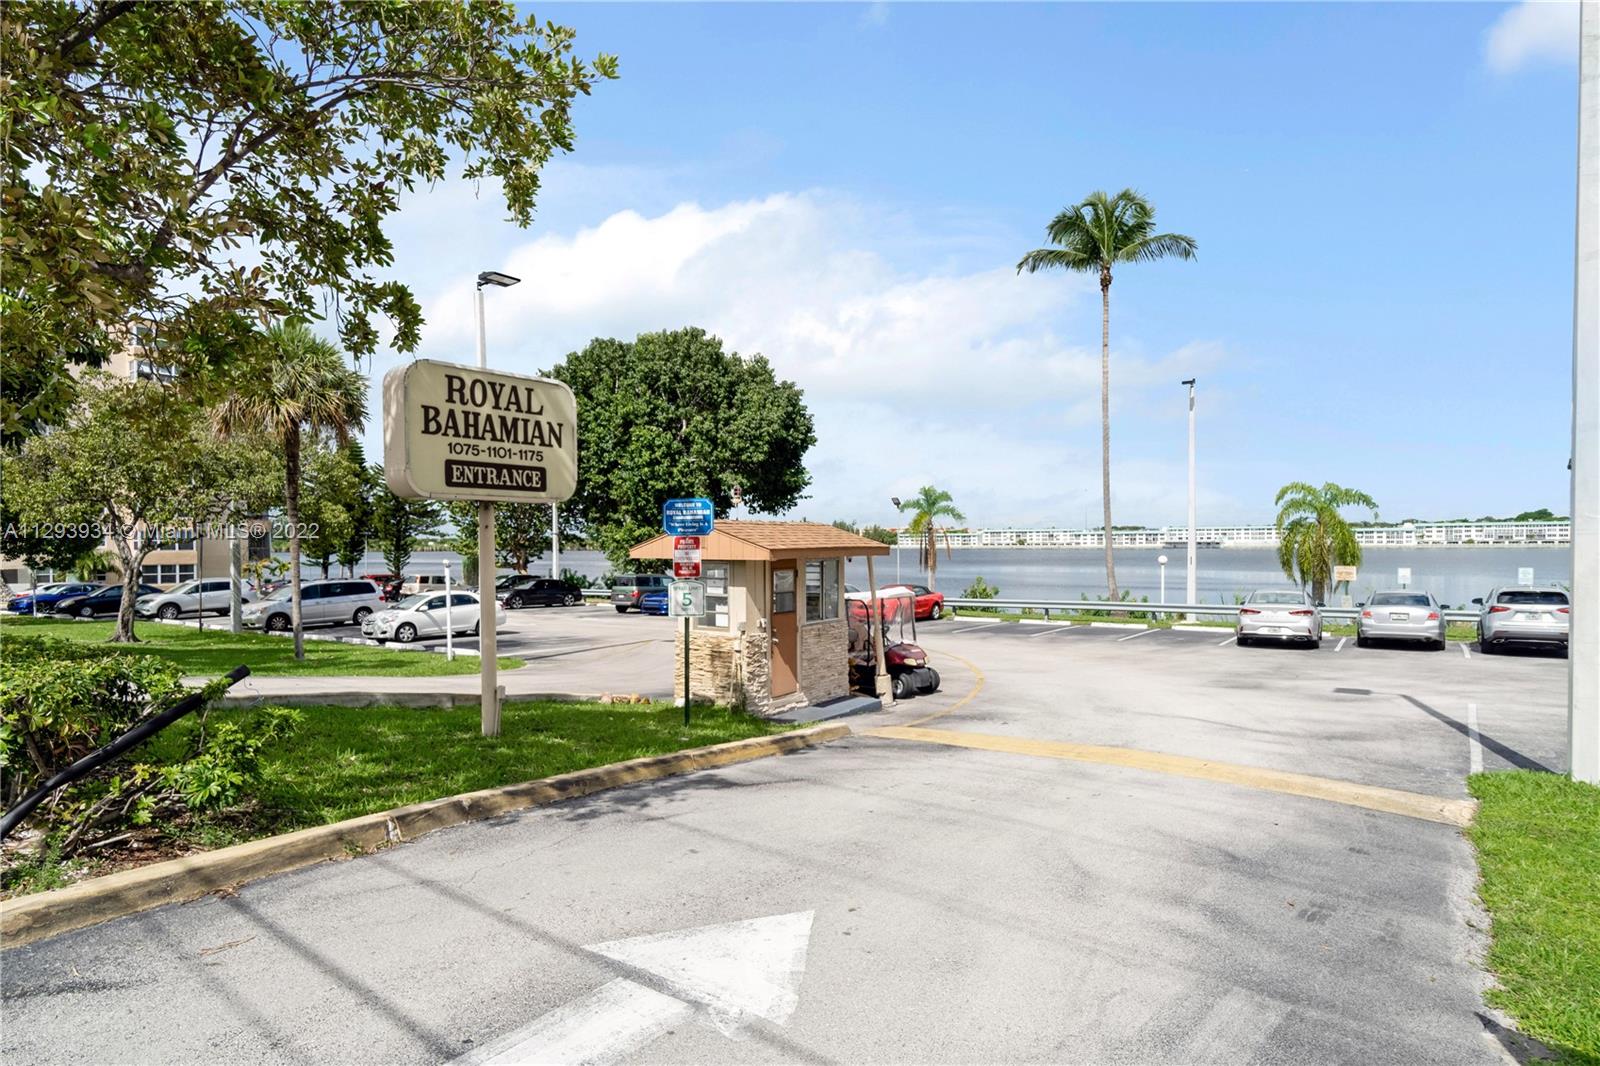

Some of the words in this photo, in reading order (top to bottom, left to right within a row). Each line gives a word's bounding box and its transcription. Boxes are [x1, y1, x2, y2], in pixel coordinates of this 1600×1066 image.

[444, 374, 544, 415] ROYAL
[421, 405, 564, 449] BAHAMIAN
[447, 442, 544, 462] 1075-1101-1175
[450, 464, 542, 488] ENTRANCE
[682, 592, 693, 606] 5
